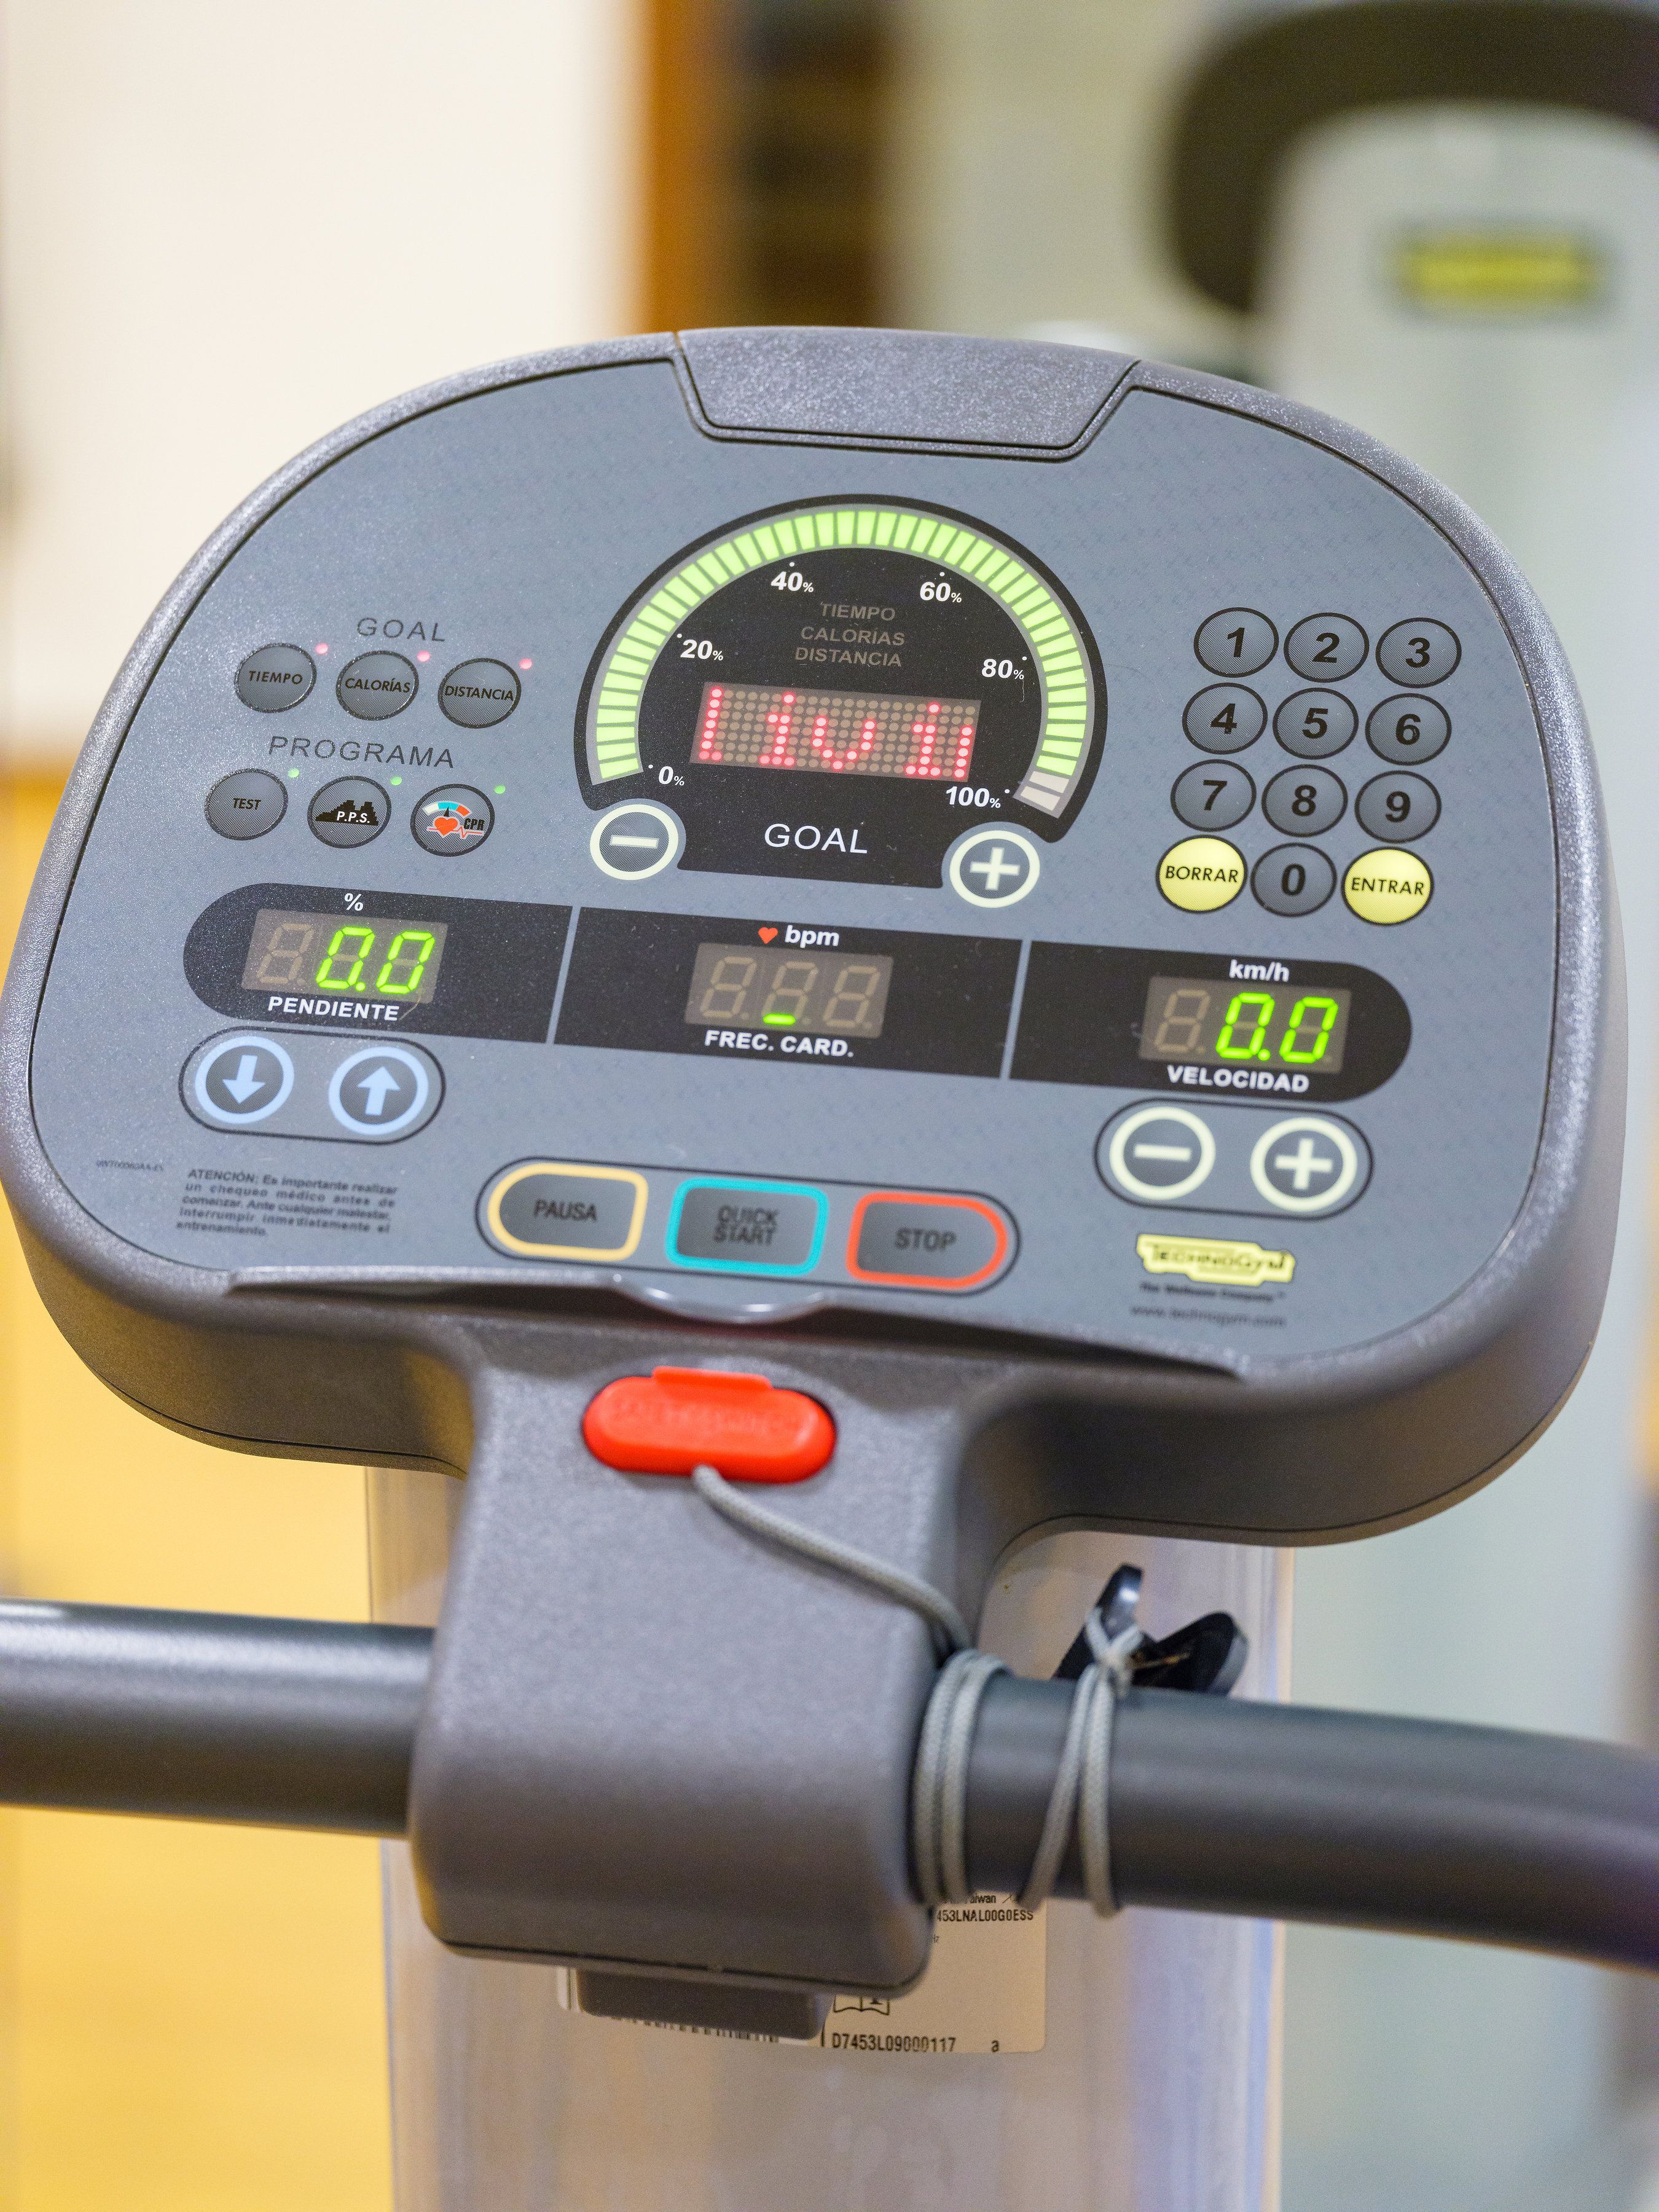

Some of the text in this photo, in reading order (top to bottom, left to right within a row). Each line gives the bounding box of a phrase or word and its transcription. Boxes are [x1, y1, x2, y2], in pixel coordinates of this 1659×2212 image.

[771, 571, 814, 592] 40%
[920, 582, 962, 603] 60%
[820, 603, 896, 621] TIEMPO
[357, 618, 446, 642] GOAL
[801, 626, 905, 646] CALORÍAS
[680, 639, 724, 662] 20%
[1226, 627, 1245, 658] 1
[1312, 632, 1341, 664] 2
[1405, 637, 1431, 669] 3
[794, 646, 902, 667] DISTANCIA
[249, 670, 303, 684] TIEMPO
[981, 659, 1025, 681] 80%
[345, 677, 410, 694] CALORÍAS
[444, 685, 514, 701] DISTANCIA
[1210, 703, 1237, 734] 4
[1302, 708, 1328, 739] 5
[1395, 713, 1421, 745] 6
[269, 735, 454, 769] PROGRAMA
[658, 766, 685, 787] 0%
[233, 798, 261, 810] TEST
[945, 786, 1001, 809] 100%
[1202, 780, 1227, 810] 7
[1292, 785, 1317, 817] 8
[336, 811, 371, 823] P.P.S.
[1385, 791, 1411, 823] 9
[464, 818, 485, 831] CPR
[764, 823, 868, 855] GOAL
[1165, 865, 1239, 883] BORRAR
[1281, 864, 1306, 896] 0
[1351, 877, 1425, 895] ENTRAR
[344, 893, 364, 911] %
[784, 925, 840, 948] bpm
[315, 926, 436, 995] 0.0
[1228, 959, 1290, 982] km/h
[268, 996, 399, 1022] PENDIENTE
[1215, 992, 1339, 1064] 0.0
[704, 1030, 854, 1057] FREC. CARD.
[1167, 1065, 1309, 1093] VELOCIDAD
[281, 1174, 348, 1191] importante
[351, 1182, 398, 1194] realizar
[210, 1184, 268, 1197] chequeo
[276, 1189, 325, 1202] médico
[333, 1194, 370, 1206] antes
[378, 1198, 395, 1208] de
[247, 1199, 276, 1211] Ante
[179, 1206, 255, 1222] interrumpir
[262, 1213, 370, 1232] inmediatamente
[533, 1200, 598, 1222] PAUSA
[717, 1206, 780, 1228] QUICK
[713, 1224, 775, 1245] START
[895, 1228, 957, 1252] STOP
[967, 1893, 997, 1904] aiwan
[990, 2039, 1000, 2053] a
